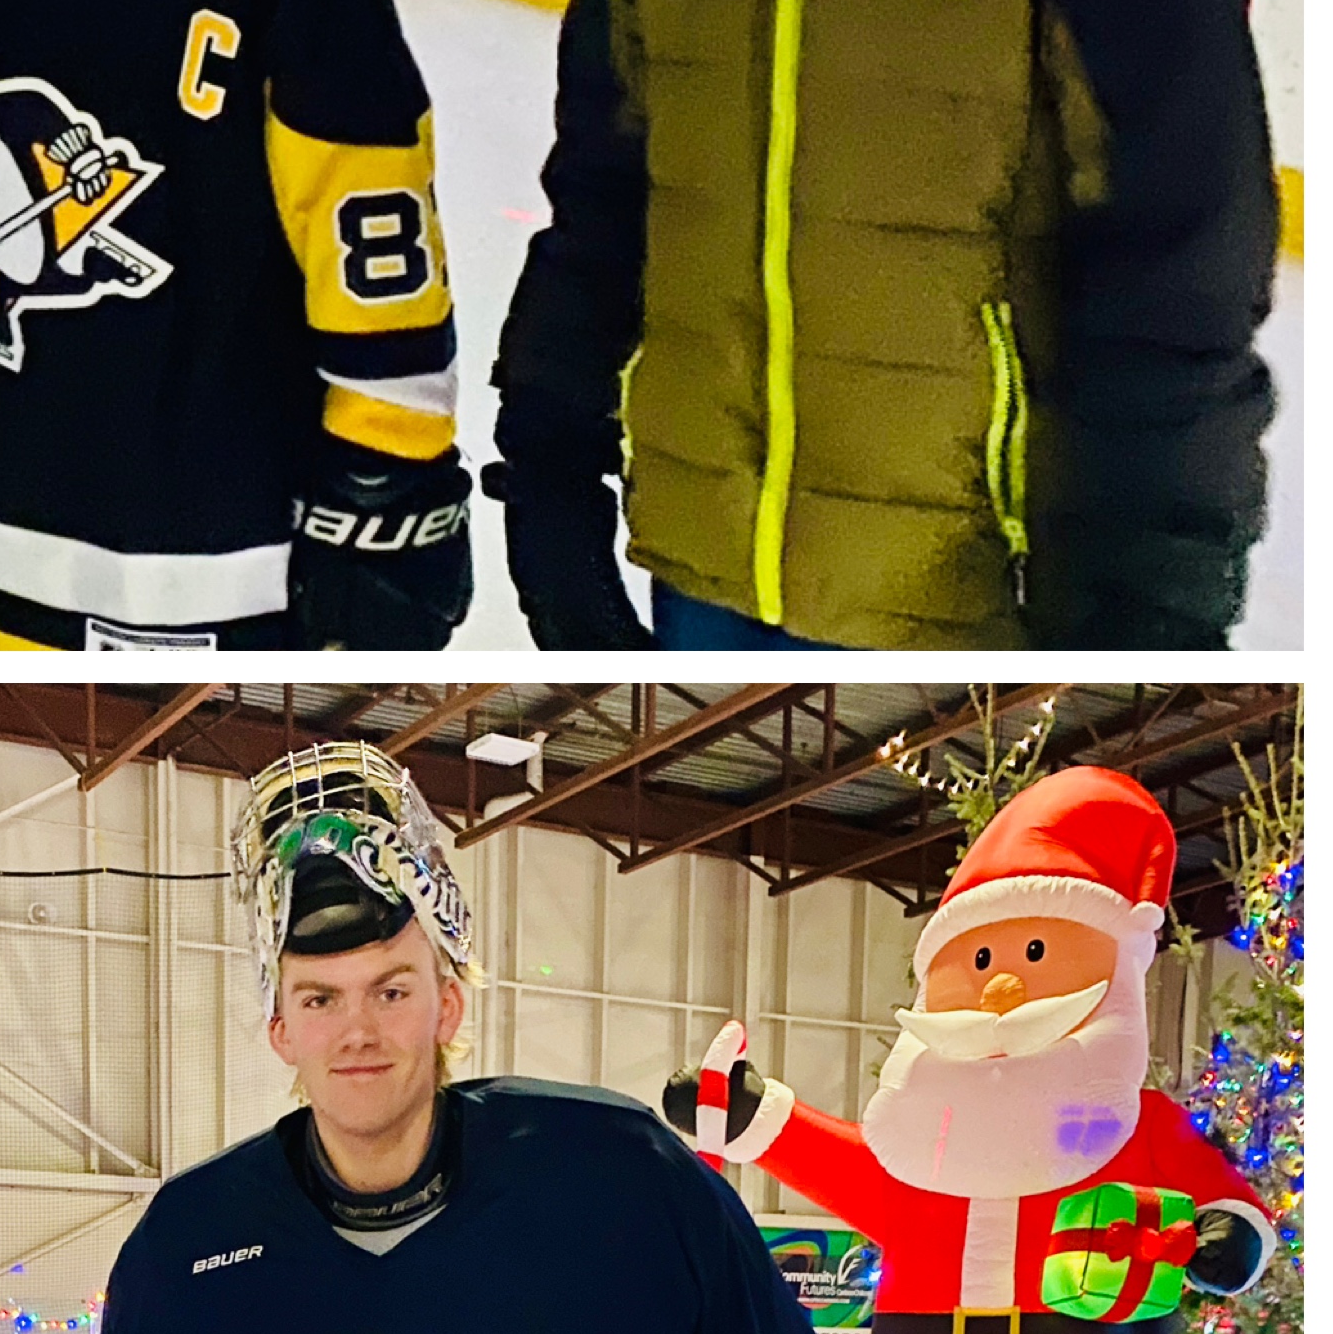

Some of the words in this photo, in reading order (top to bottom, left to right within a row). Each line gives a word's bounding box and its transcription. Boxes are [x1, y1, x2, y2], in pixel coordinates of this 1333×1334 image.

[178, 8, 241, 121] C
[191, 1244, 264, 1275] BAUER
[782, 1270, 837, 1287] ommunity
